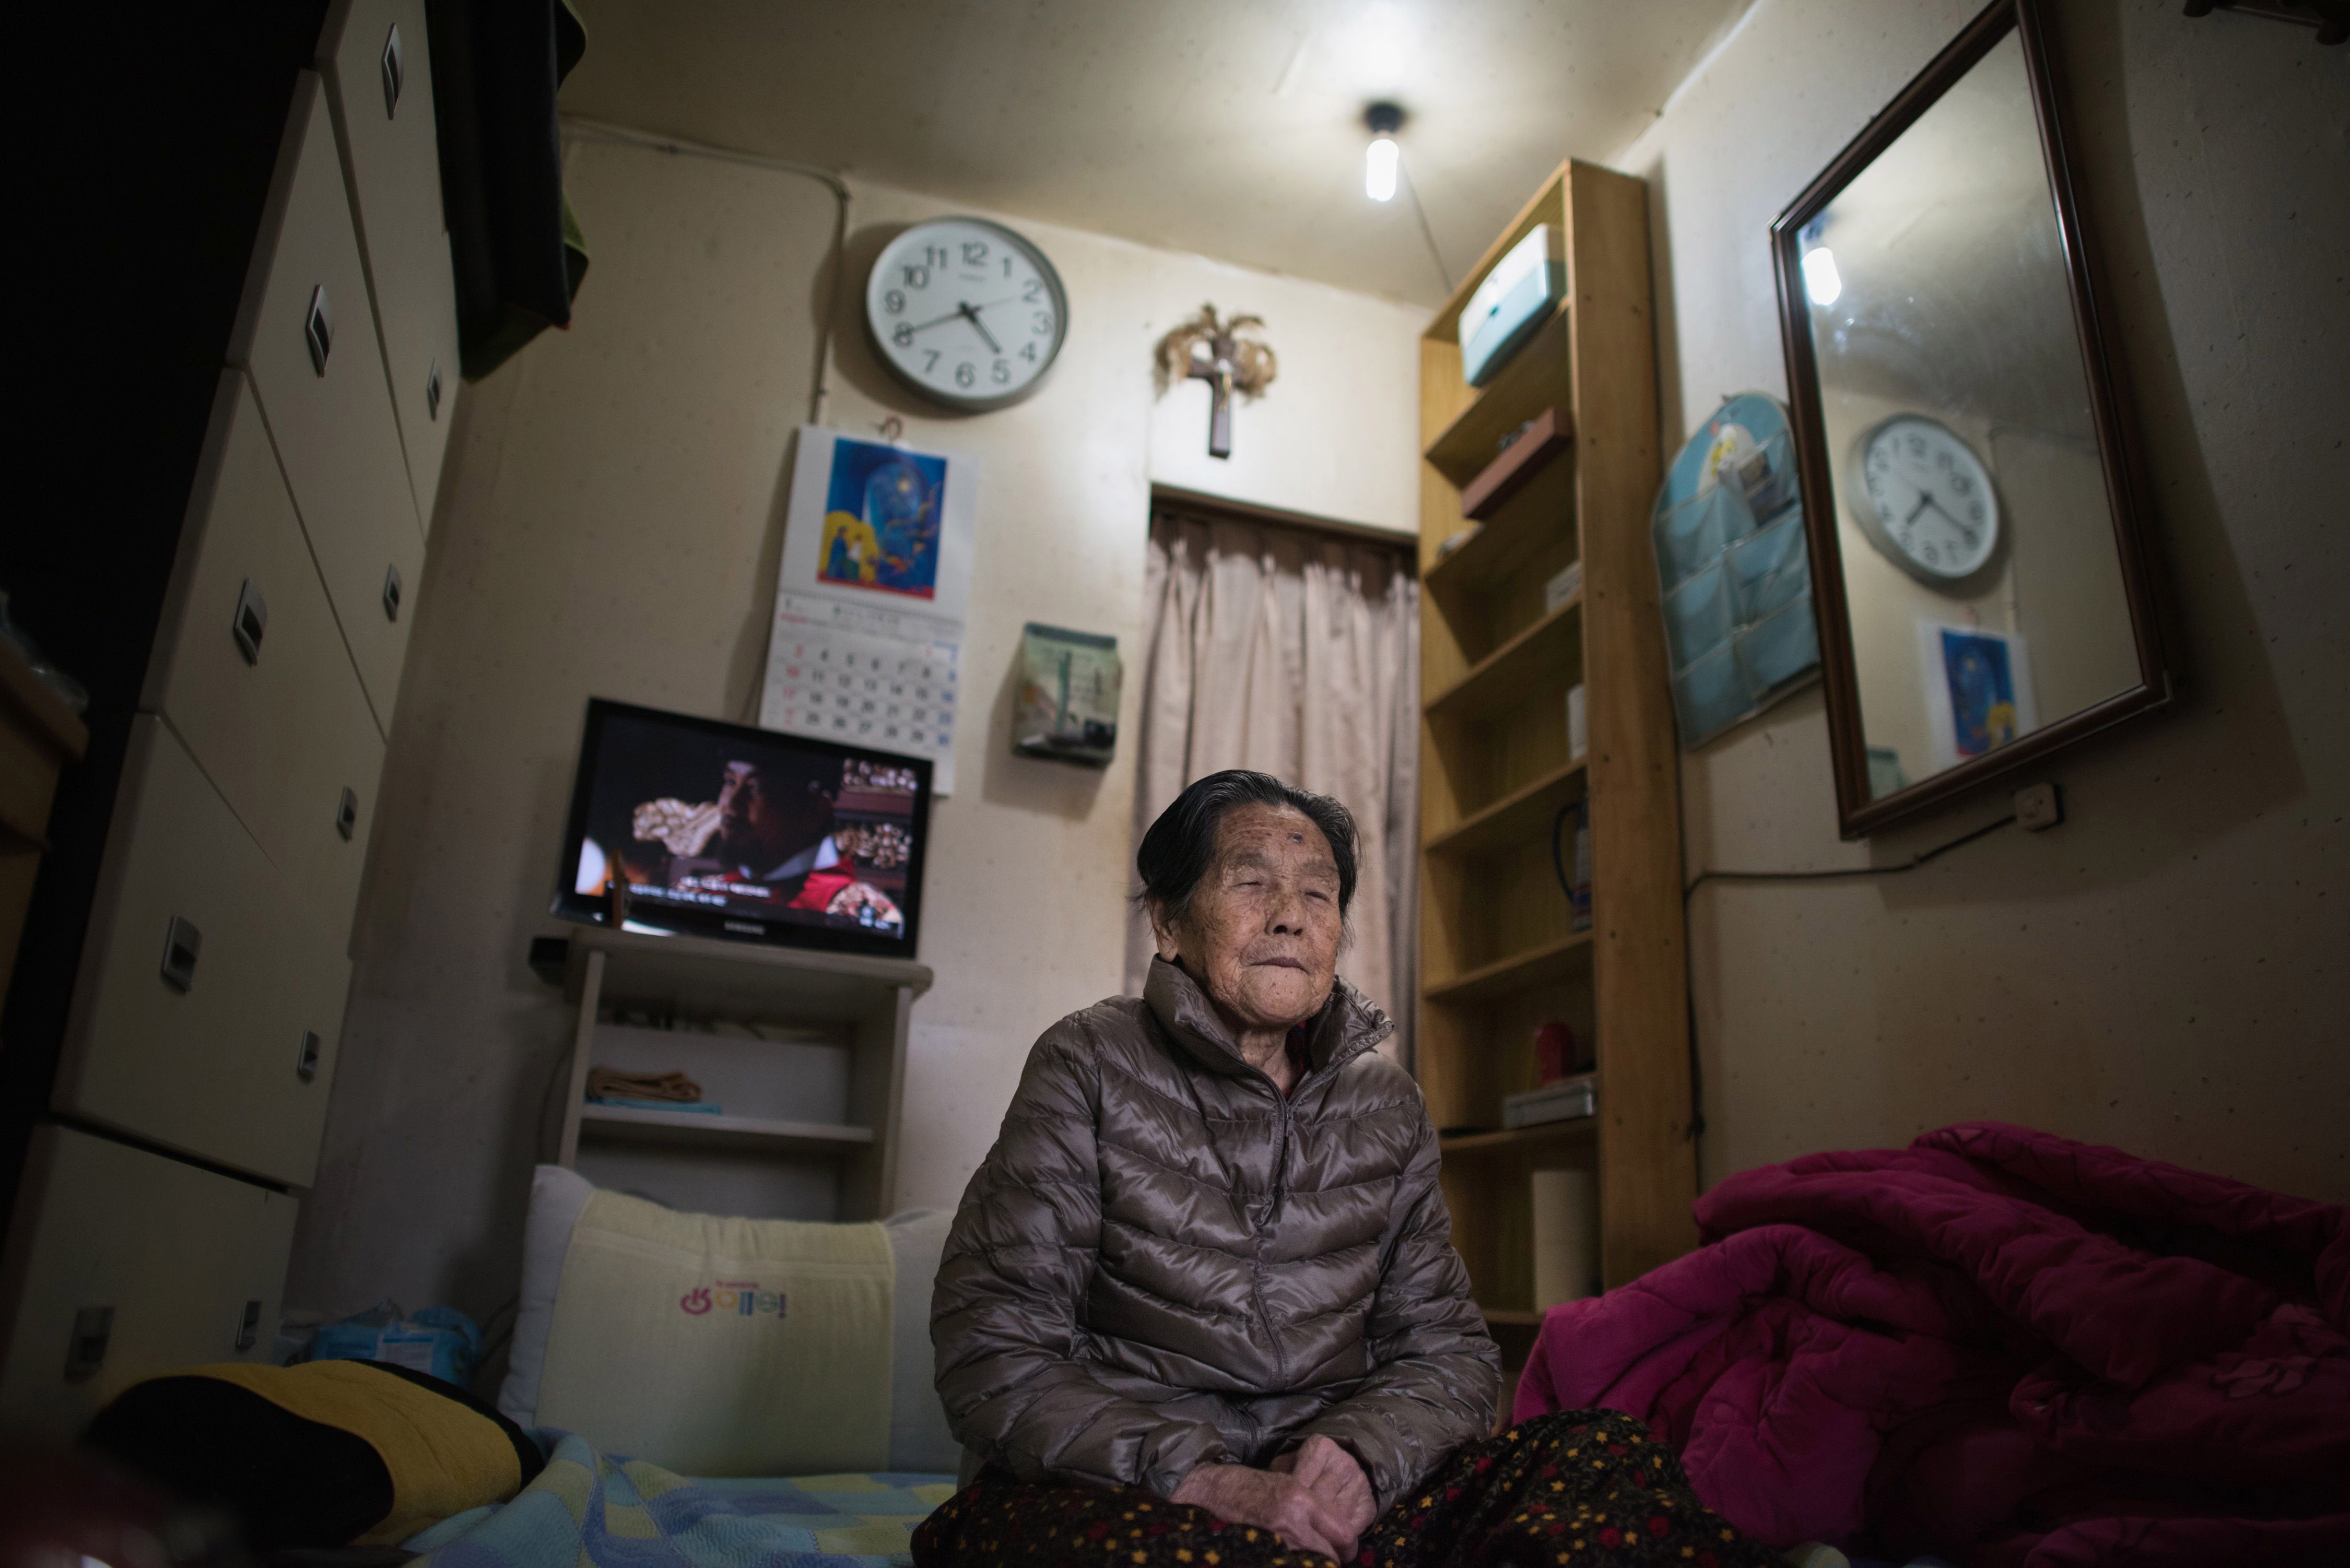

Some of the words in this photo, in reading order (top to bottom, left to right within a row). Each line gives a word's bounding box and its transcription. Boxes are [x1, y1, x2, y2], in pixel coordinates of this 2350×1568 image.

[925, 245, 947, 269] 11
[961, 242, 988, 266] 12
[903, 265, 930, 288] 10
[1003, 257, 1012, 278] 1
[885, 290, 906, 314] 9
[1022, 279, 1041, 302] 2
[892, 321, 913, 346] 8
[1031, 310, 1050, 335] 3
[923, 349, 941, 373] 7
[1018, 342, 1036, 362] 4
[956, 362, 976, 387] 6
[991, 359, 1010, 384] 5
